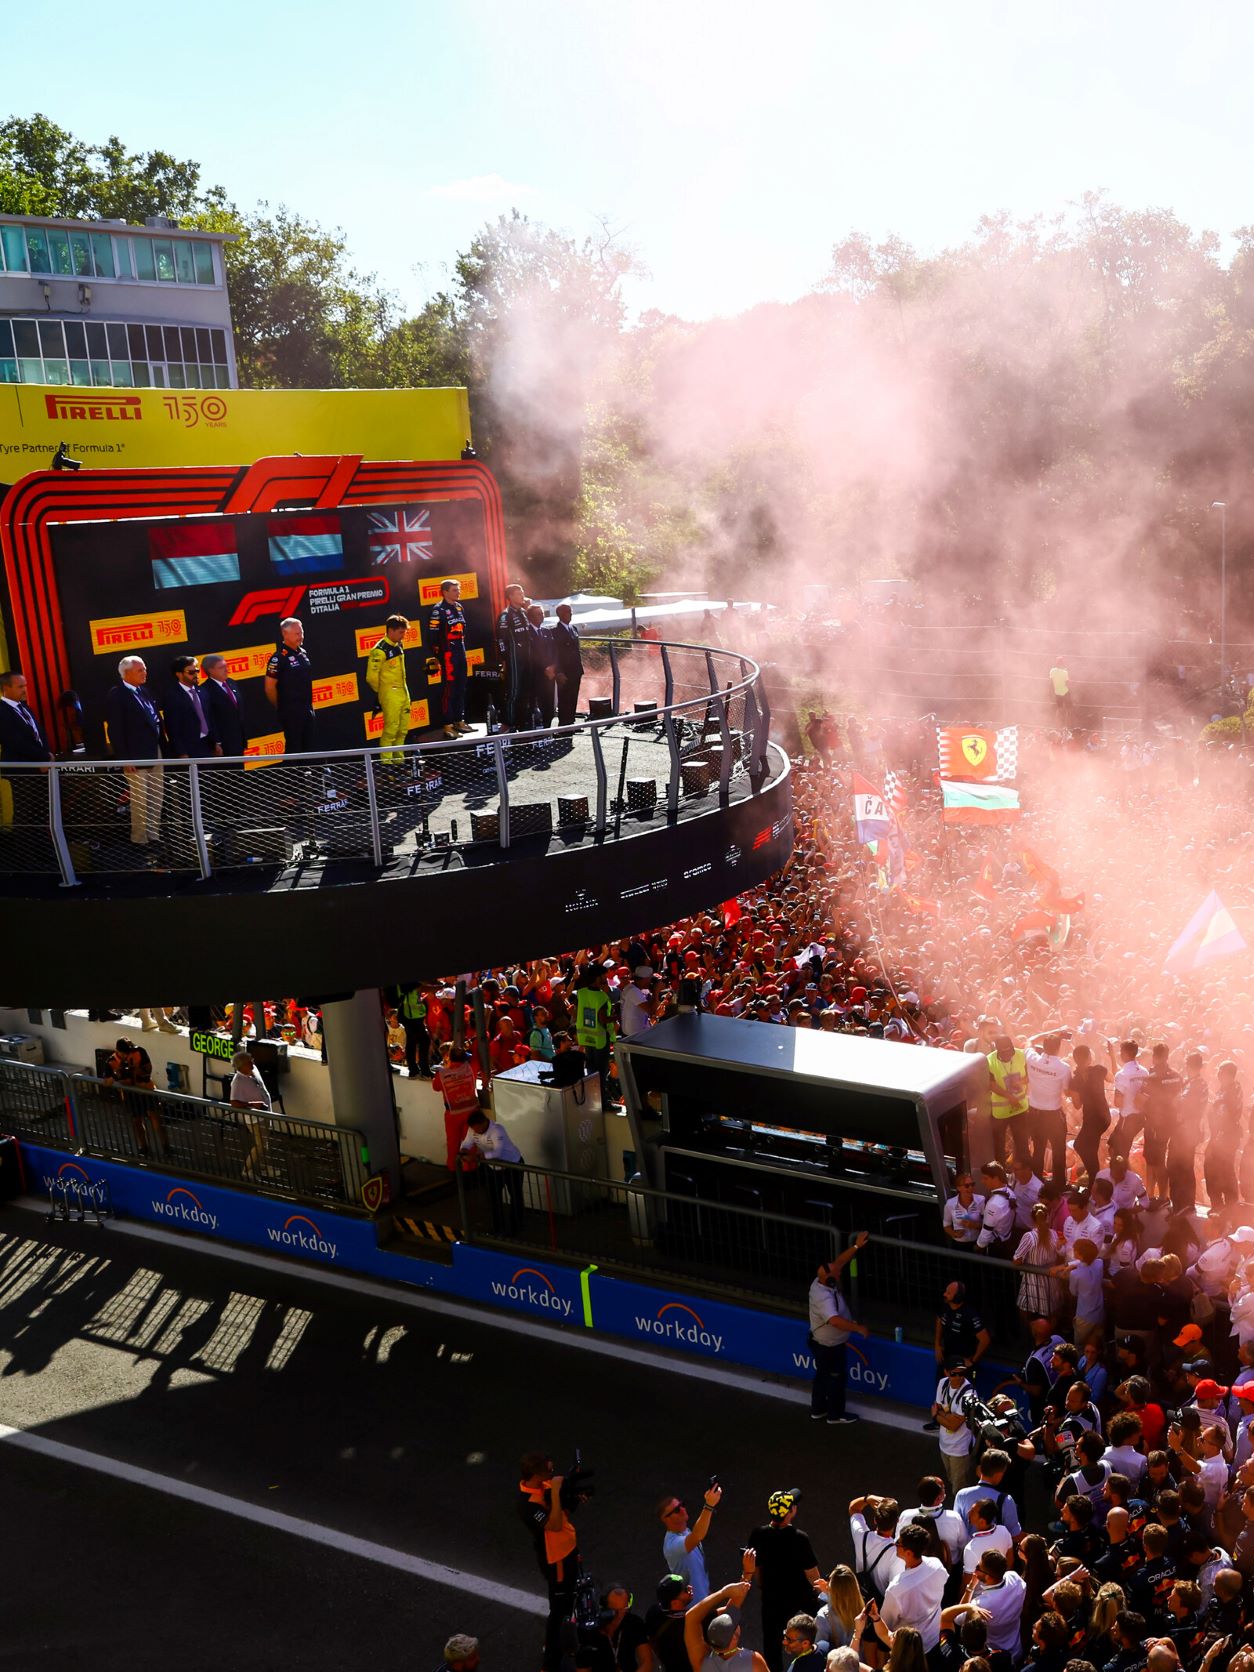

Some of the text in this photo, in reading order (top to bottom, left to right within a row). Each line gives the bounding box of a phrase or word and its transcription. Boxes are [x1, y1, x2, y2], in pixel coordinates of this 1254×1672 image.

[45, 395, 227, 428] PIRELLI 150
[22, 443, 58, 453] Partner
[73, 443, 114, 453] Formula
[309, 586, 345, 597] FORMULA
[309, 589, 383, 606] PIRELLI GRAN PREMIO
[96, 619, 182, 646] PIRELLI 150
[475, 670, 503, 678] FERRA
[312, 686, 333, 703] ELLI
[193, 1032, 235, 1059] GEORGE
[152, 1200, 217, 1230] workday
[268, 1227, 337, 1259] workday
[492, 1281, 572, 1316] workday
[635, 1316, 723, 1353] workday
[793, 1353, 888, 1391] wday
[1148, 1565, 1177, 1584] ORACLE
[1123, 1656, 1149, 1672] ORAC
